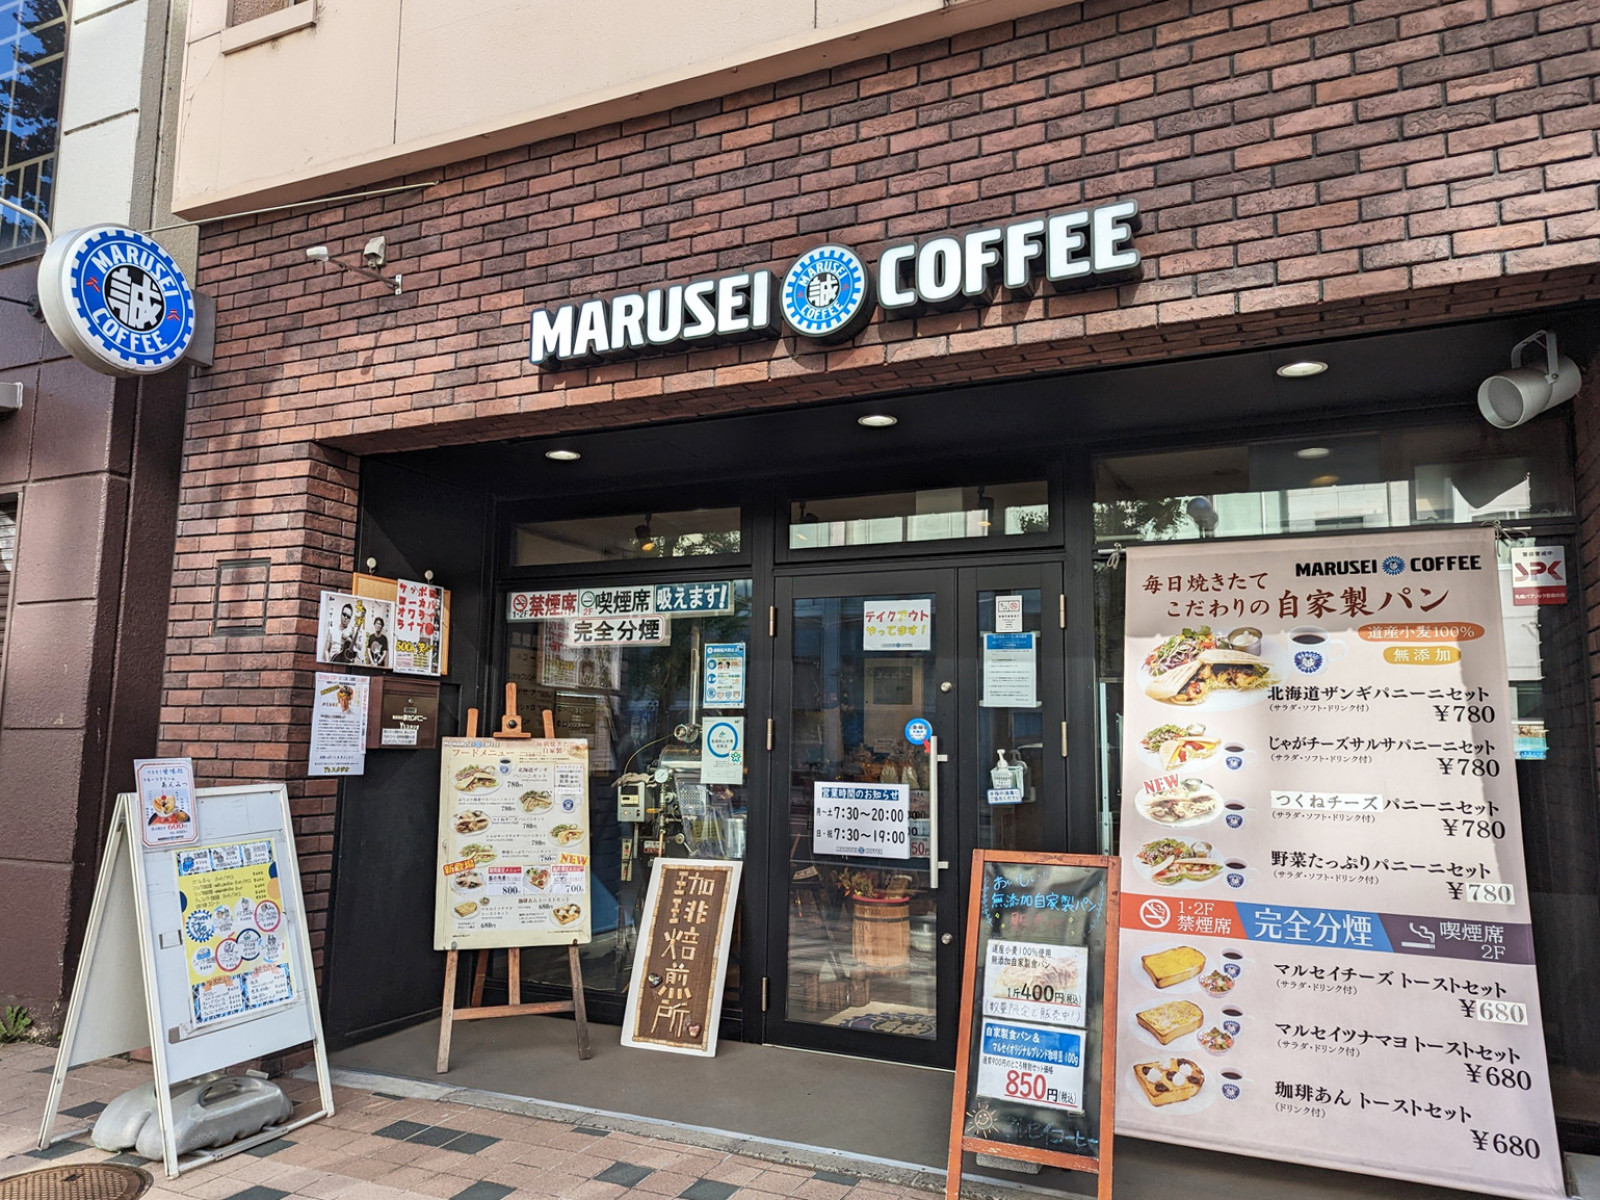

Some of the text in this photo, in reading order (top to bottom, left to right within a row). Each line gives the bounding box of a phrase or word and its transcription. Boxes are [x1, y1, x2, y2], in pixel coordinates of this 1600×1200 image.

[91, 244, 179, 297] MARUSEI
[798, 260, 848, 287] MARUSEI
[531, 202, 1140, 364] MARUSEI COFFEE
[801, 301, 844, 320] COFFEE
[92, 308, 168, 352] COFFEE
[1295, 554, 1482, 577] MARUSEI COFFEE
[1515, 560, 1564, 581] SPK
[1142, 571, 1268, 593] 毎日焼きたて
[529, 593, 578, 617] 禁煙席
[596, 588, 651, 614] 喫煙席
[656, 583, 728, 611] 吸えます!
[1166, 587, 1450, 620] こだわりの自家製パン
[583, 607, 593, 616] 2F
[865, 610, 930, 623] テイクアウト
[573, 619, 660, 642] 完全分煙
[1366, 624, 1475, 641] 道産小麦100%
[1393, 647, 1452, 662] 無添加
[1267, 686, 1489, 702] 北海道ザンギパニーニセット
[1433, 704, 1495, 723] ¥780
[452, 749, 515, 757] フードメニュー
[1269, 735, 1495, 753] じゃがチーズサルサパニーニセット
[1437, 757, 1500, 777] ¥780
[821, 788, 899, 800] 営業時間のお知らせ
[1144, 773, 1180, 794] NEW
[1441, 818, 1506, 839] ¥780
[560, 854, 588, 865] NEW
[1271, 850, 1491, 880] 野菜たっぷりパニーニセット
[991, 892, 1097, 912] 無添加自家製パン
[1446, 881, 1512, 903] ¥780
[1177, 914, 1232, 935] 禁煙席
[1254, 908, 1374, 947] 完全分煙
[1439, 921, 1504, 945] 喫煙席
[651, 871, 715, 1037] 珈琲焙煎所
[1481, 945, 1506, 960] 2F
[1460, 998, 1524, 1023] ¥680
[1466, 1063, 1532, 1092] ¥680
[1471, 1129, 1541, 1160] ¥680
